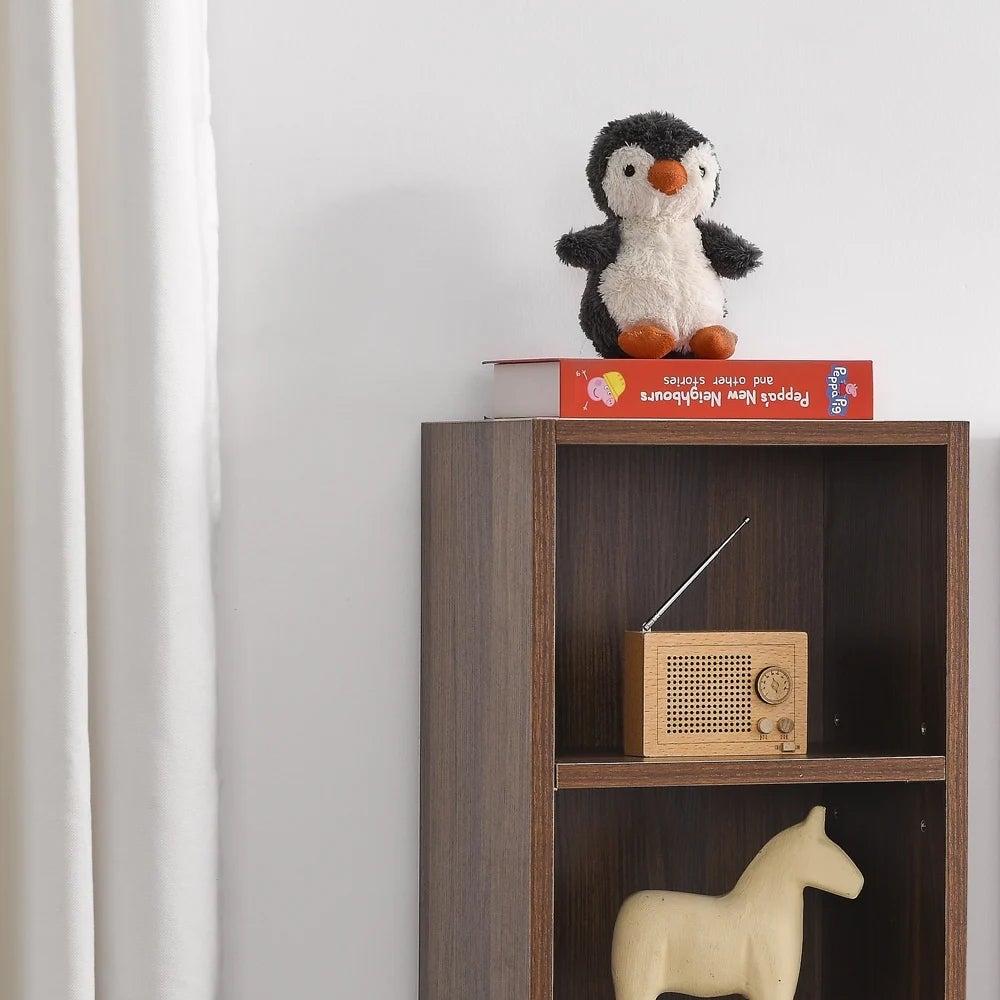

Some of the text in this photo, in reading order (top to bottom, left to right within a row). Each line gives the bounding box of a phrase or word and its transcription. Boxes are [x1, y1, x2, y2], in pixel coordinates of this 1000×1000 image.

[663, 376, 774, 387] and other stories
[827, 367, 848, 414] Peppa Pig
[640, 386, 810, 408] Peppa's New Neighbours
